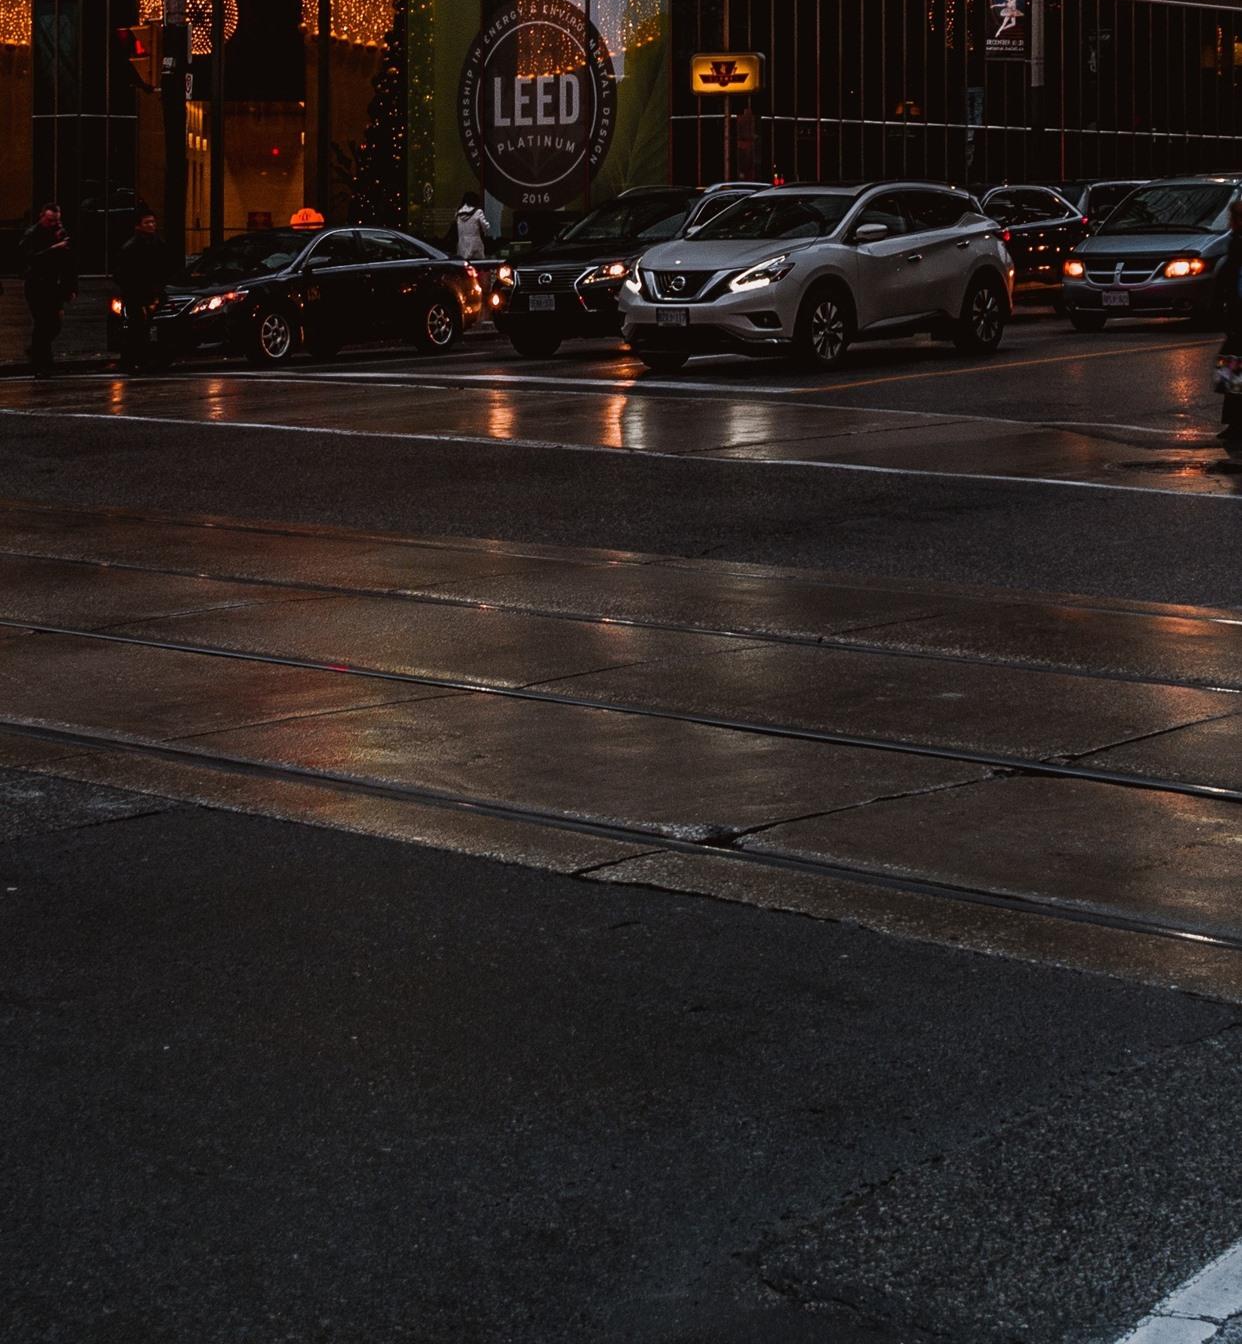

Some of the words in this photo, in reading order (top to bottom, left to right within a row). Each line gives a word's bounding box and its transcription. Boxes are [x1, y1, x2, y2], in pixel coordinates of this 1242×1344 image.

[472, 48, 482, 64] IN
[484, 6, 524, 44] ENERGY
[589, 107, 611, 165] DESIGN
[493, 73, 581, 127] LEED
[497, 135, 576, 155] PLATINUM
[522, 192, 550, 205] 2016
